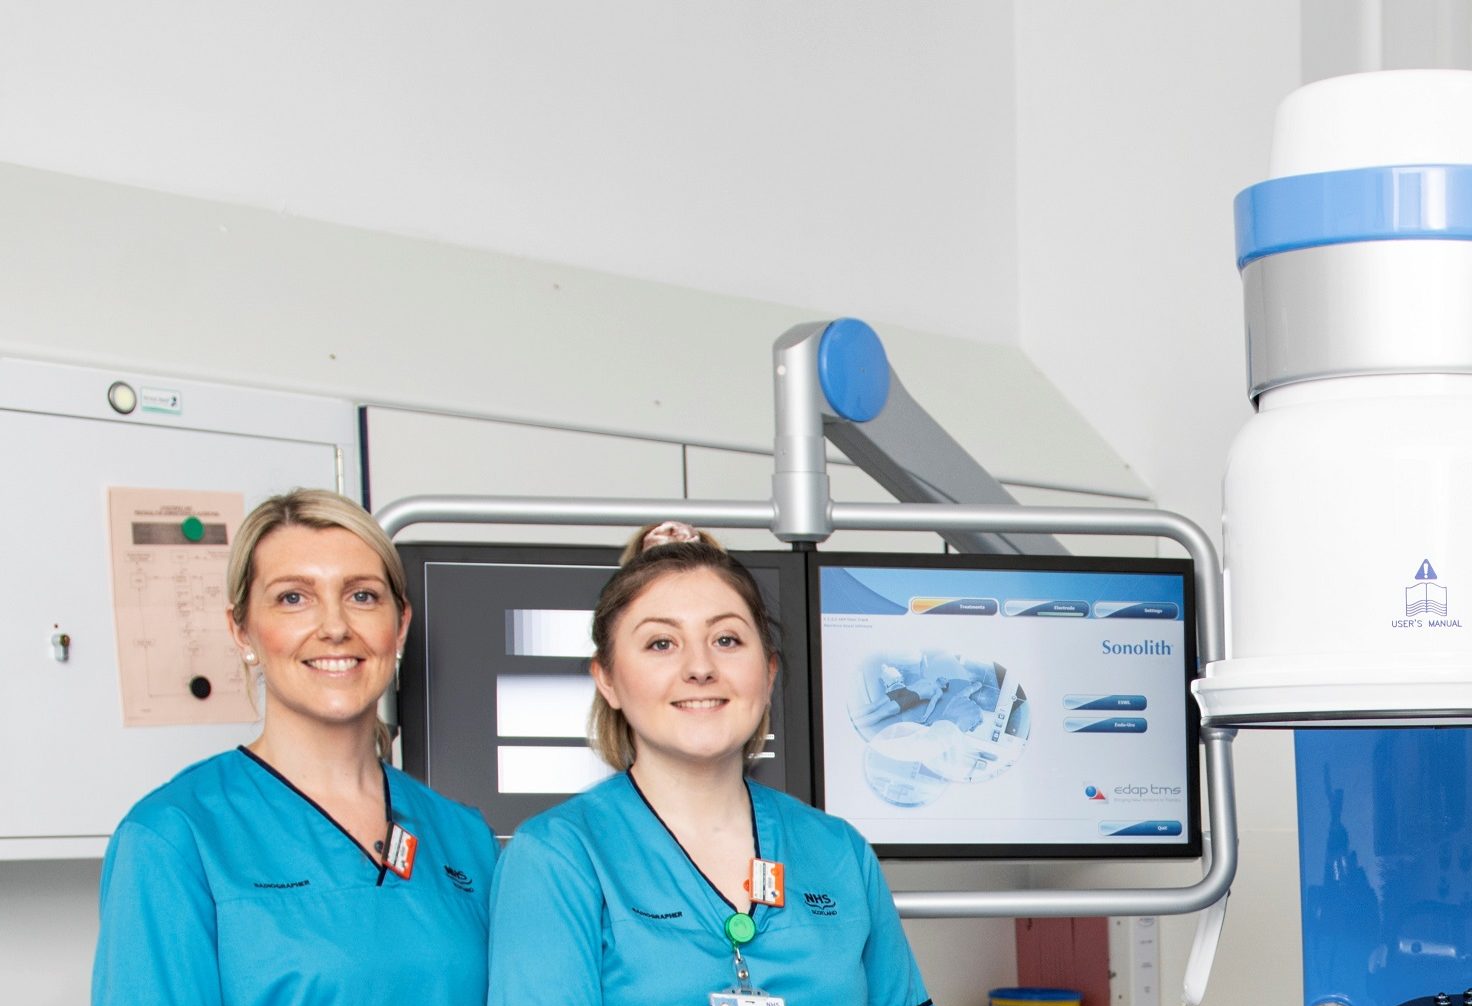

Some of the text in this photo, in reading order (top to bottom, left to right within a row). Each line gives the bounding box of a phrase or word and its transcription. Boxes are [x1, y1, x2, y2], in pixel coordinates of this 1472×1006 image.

[959, 603, 986, 611] Treatments
[1053, 604, 1076, 612] Electrode
[1143, 607, 1163, 615] Settings
[1391, 619, 1463, 628] USER'S MANUAL
[1102, 639, 1171, 656] Sonolith
[1114, 783, 1182, 797] edap tms
[804, 893, 832, 904] NHS
